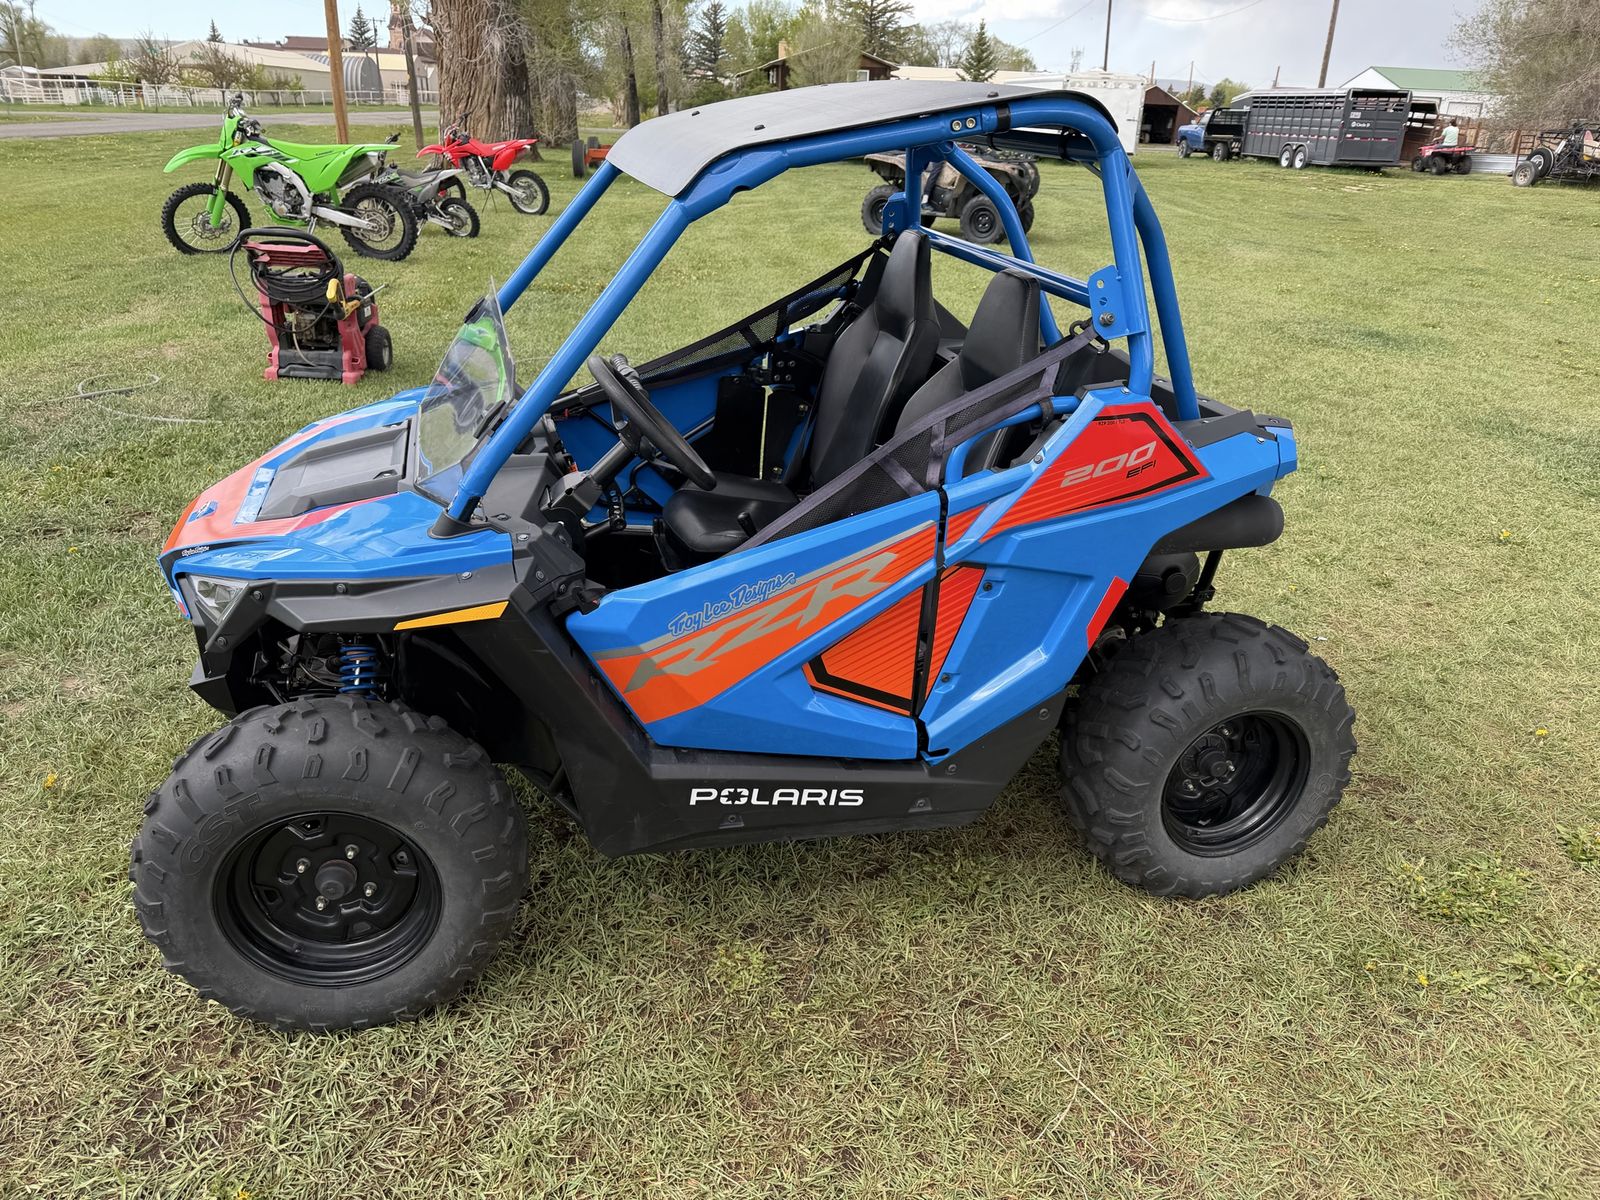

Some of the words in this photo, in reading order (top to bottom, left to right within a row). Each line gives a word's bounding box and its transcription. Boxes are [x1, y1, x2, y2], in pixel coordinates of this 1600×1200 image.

[1060, 441, 1157, 488] 200
[1126, 460, 1157, 479] EFI
[623, 552, 899, 694] RZR
[668, 611, 703, 636] Troy
[703, 601, 732, 621] Lee
[729, 572, 796, 609] Designs
[689, 788, 864, 806] POLARIS
[179, 791, 260, 876] CST
